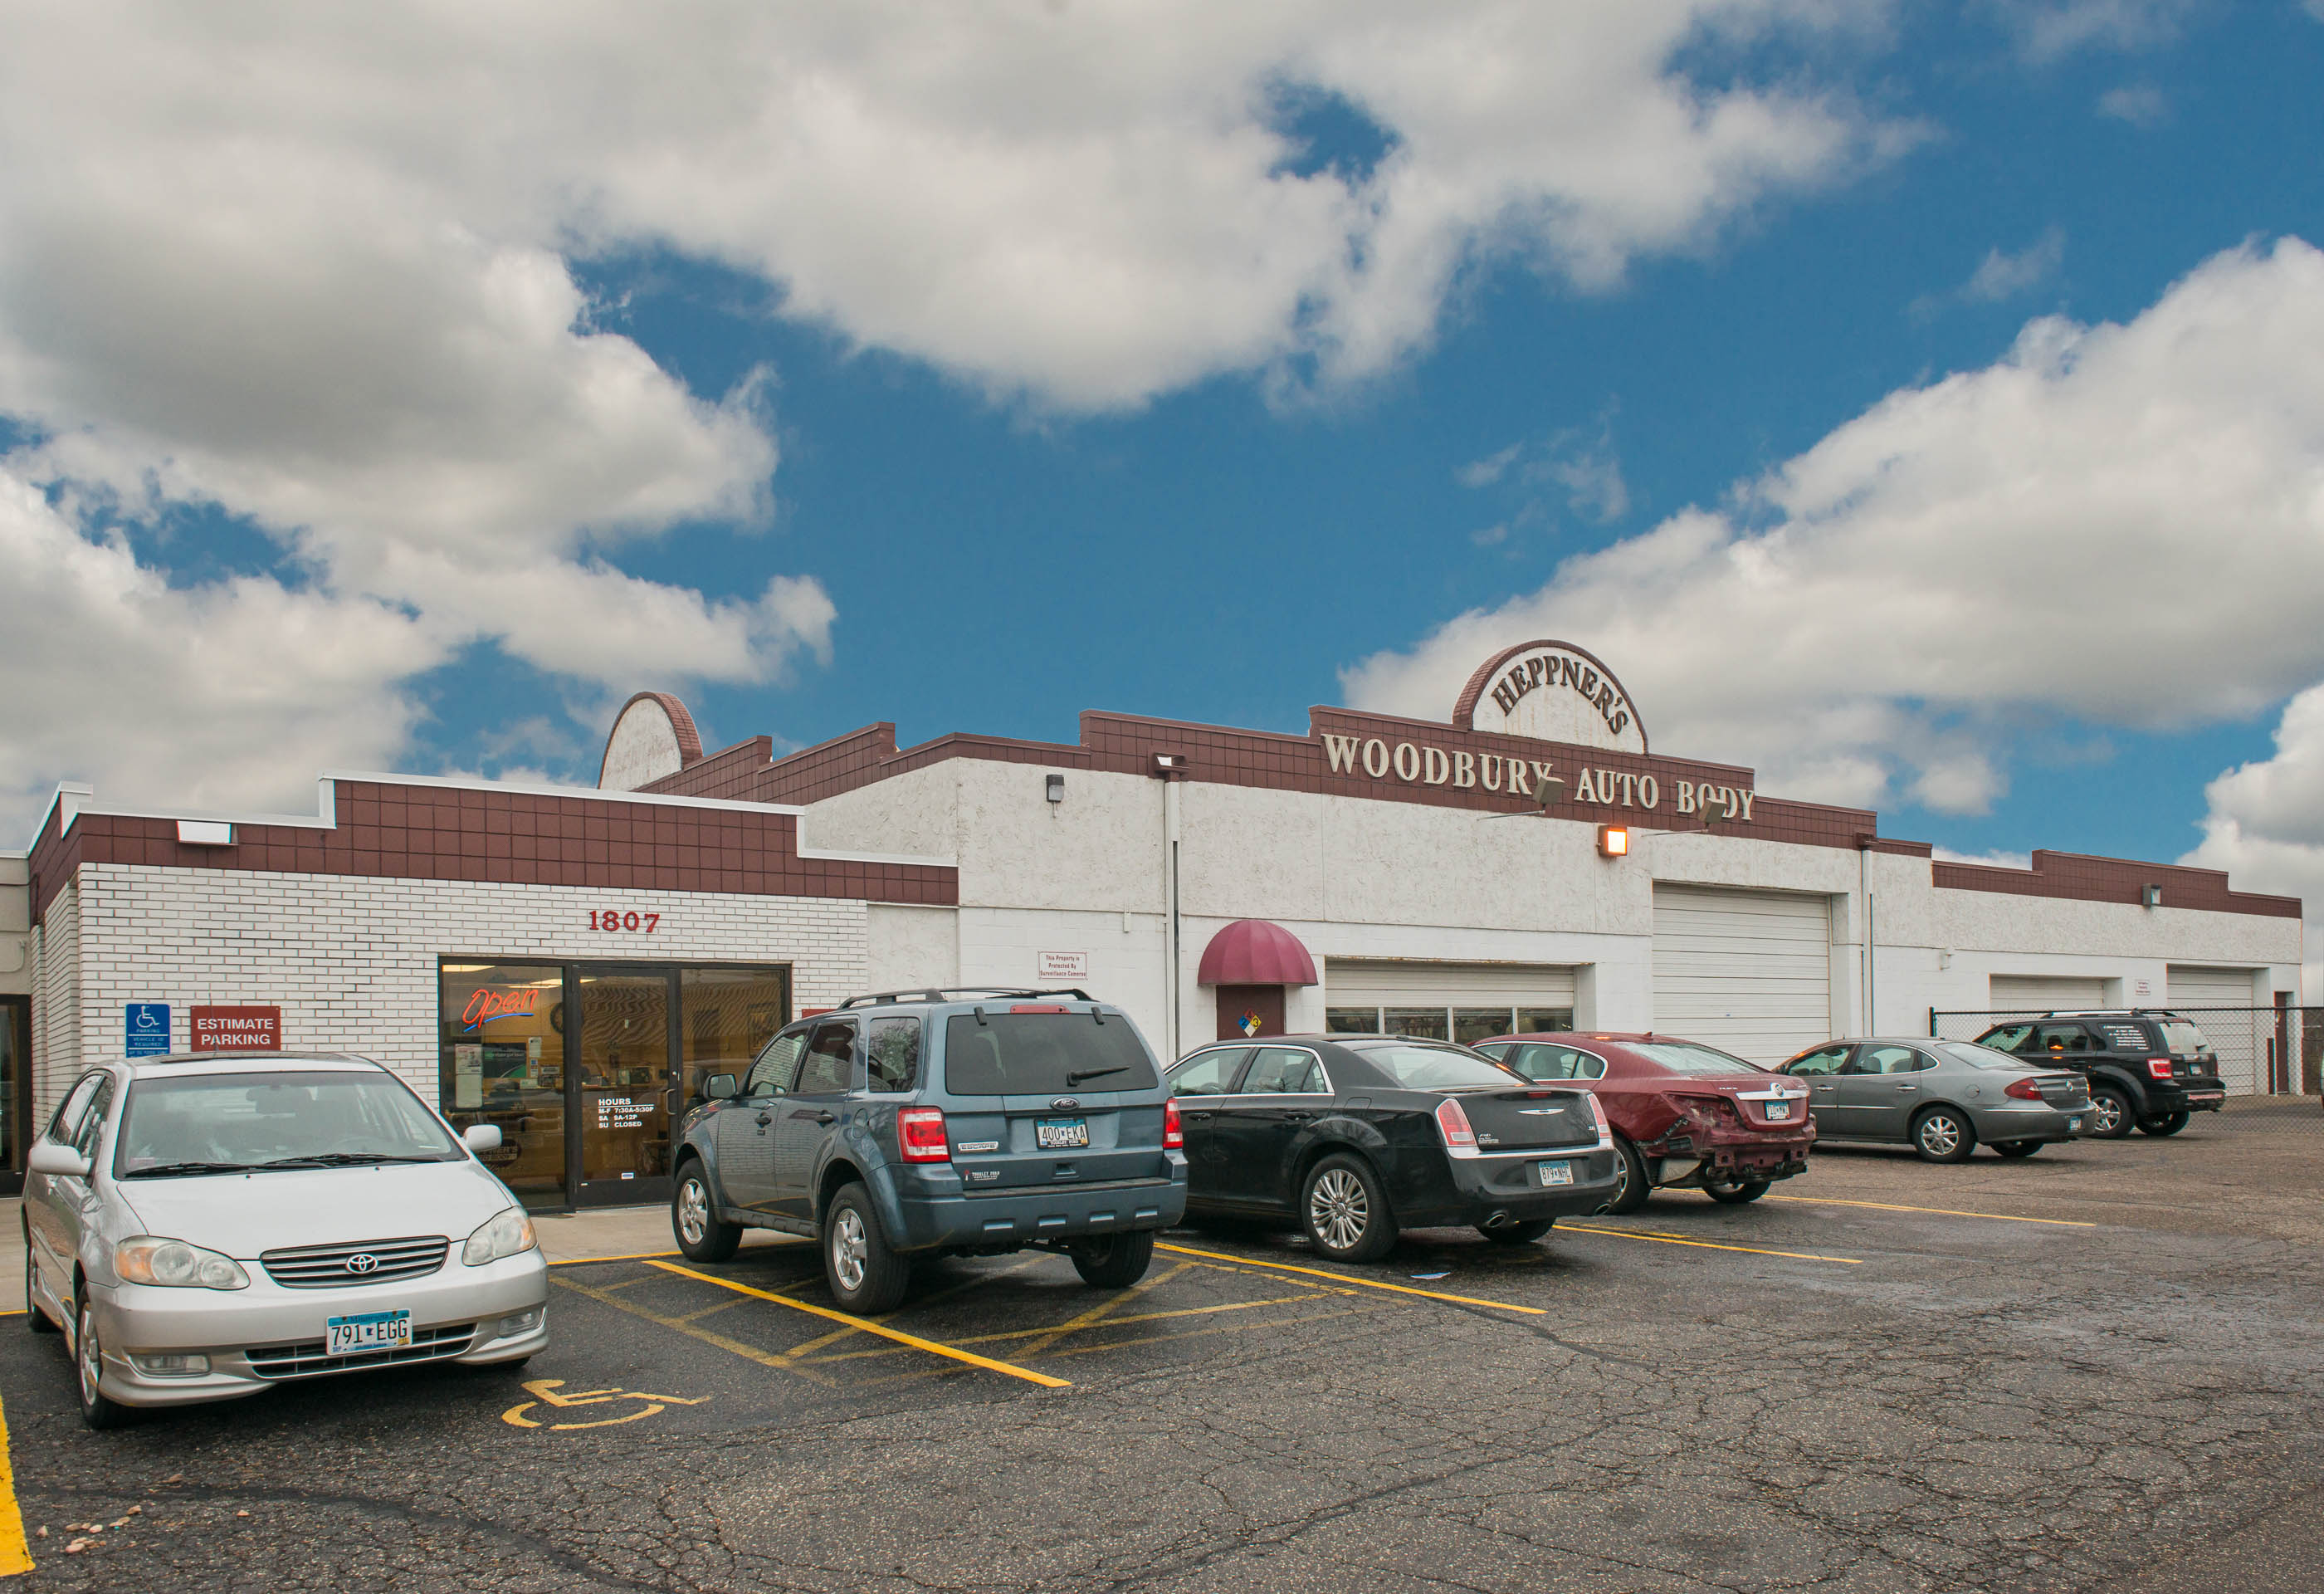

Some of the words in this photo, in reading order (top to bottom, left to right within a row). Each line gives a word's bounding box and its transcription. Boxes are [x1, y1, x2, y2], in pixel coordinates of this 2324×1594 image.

[1491, 655, 1628, 735] HEPPNER'S
[1321, 733, 1553, 795] WOODBURY
[1574, 767, 1659, 809] AUTO
[1676, 780, 1755, 820] BODY
[588, 910, 661, 933] 1807
[462, 989, 539, 1028] Open
[197, 1018, 274, 1030] ESTIMATE
[1241, 1016, 1247, 1026] 2
[1252, 1017, 1259, 1028] 3
[201, 1034, 271, 1046] PARKING
[598, 1098, 632, 1106] HOURS
[1042, 1127, 1061, 1141] 400
[1067, 1126, 1086, 1140] EKA
[332, 1324, 364, 1346] 791
[376, 1318, 408, 1341] EGG
